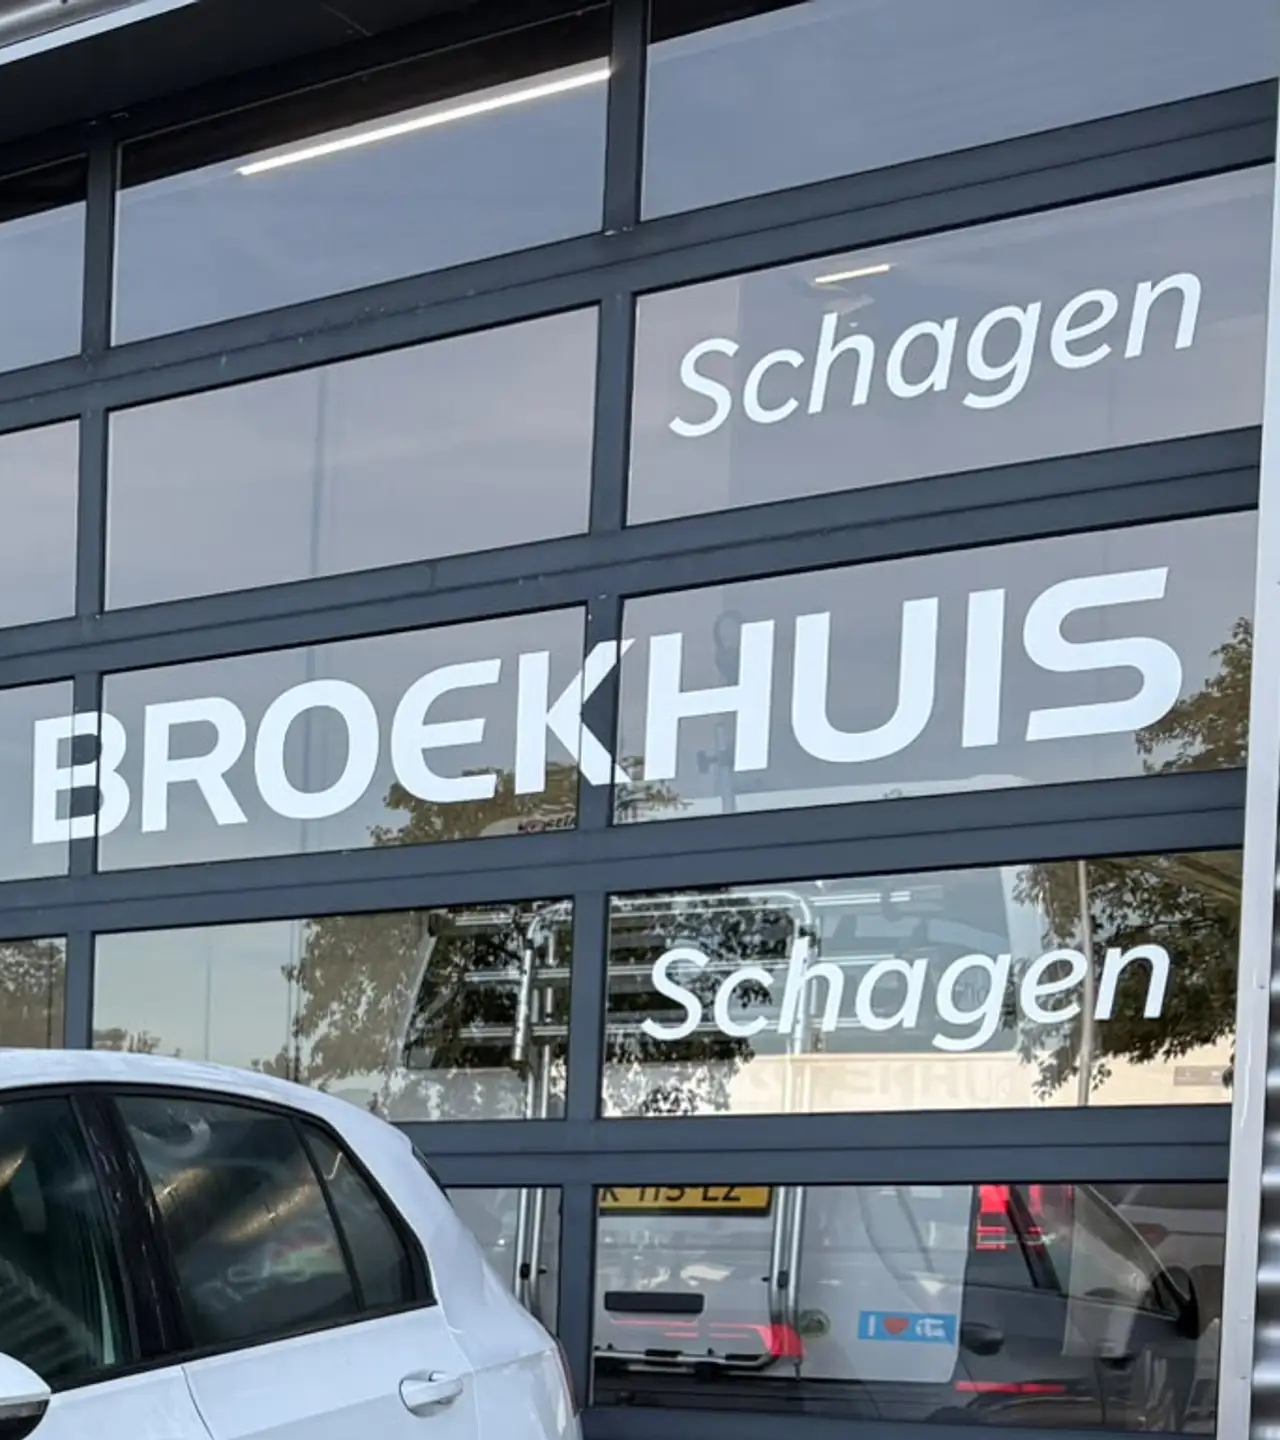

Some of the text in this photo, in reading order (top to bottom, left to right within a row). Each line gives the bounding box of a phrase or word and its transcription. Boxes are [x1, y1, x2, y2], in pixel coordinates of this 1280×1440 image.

[668, 270, 1203, 438] Schagen
[31, 565, 1184, 845] BROEKHUIS
[640, 936, 1171, 1052] Schagen
